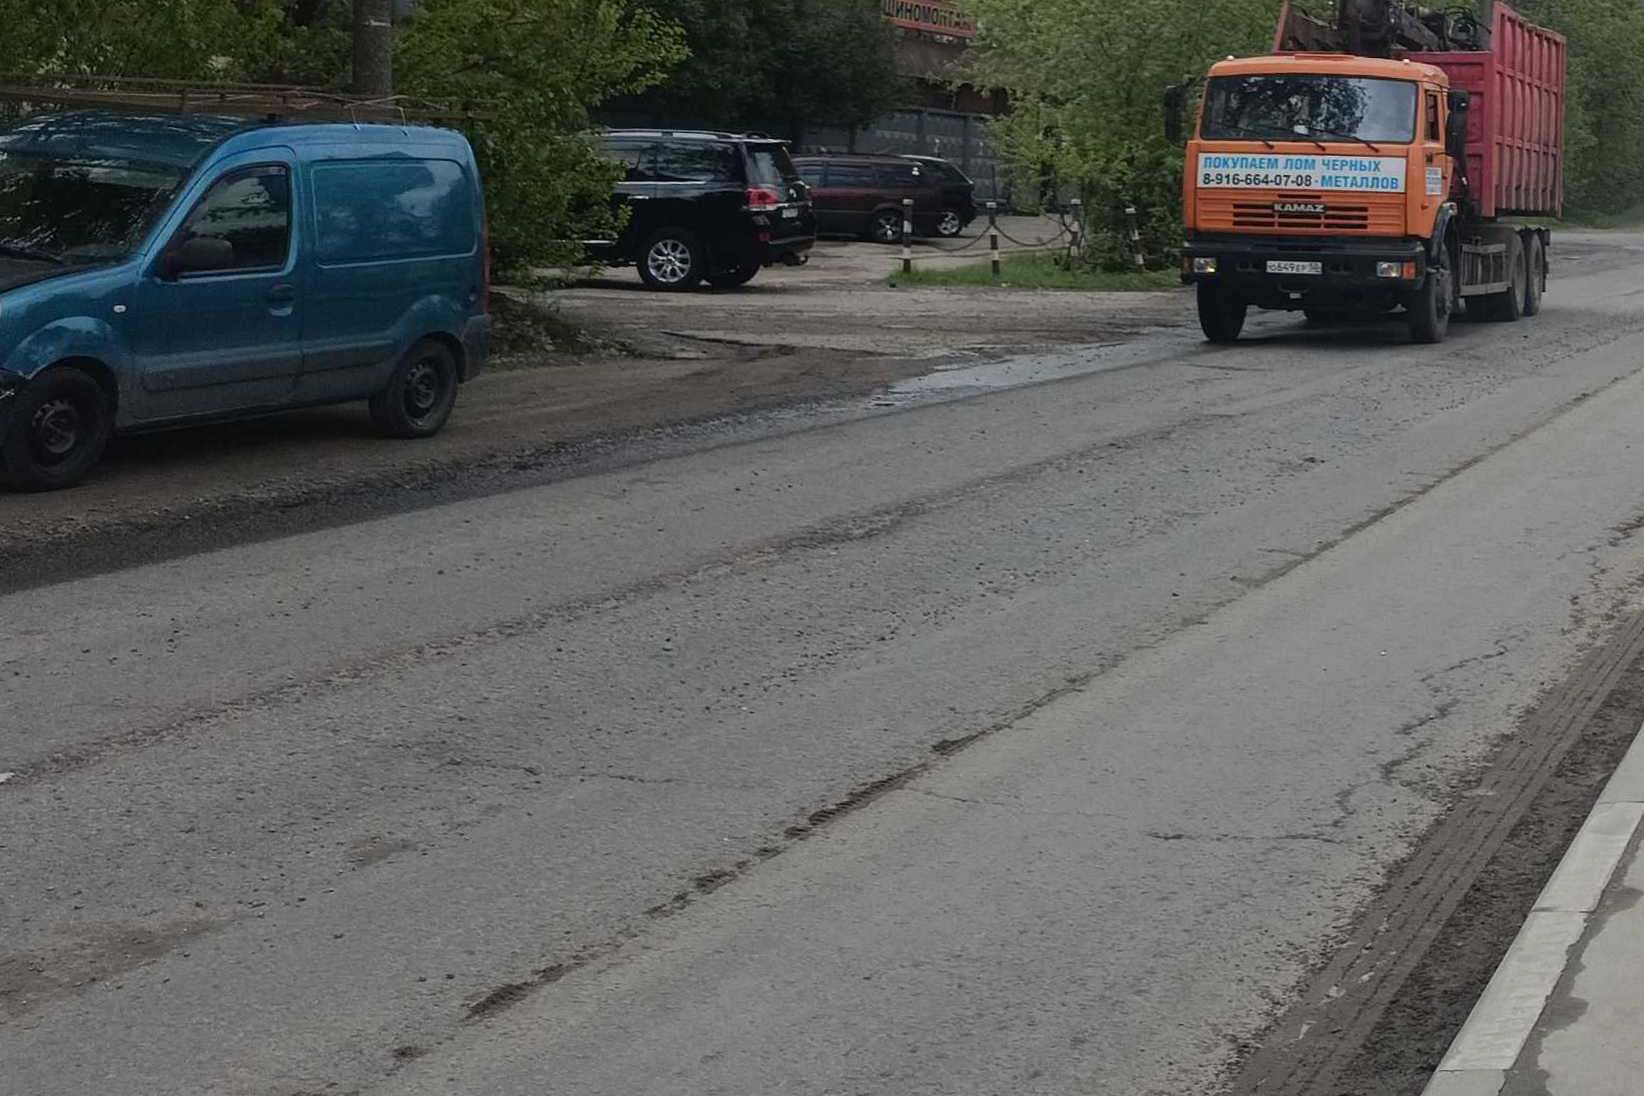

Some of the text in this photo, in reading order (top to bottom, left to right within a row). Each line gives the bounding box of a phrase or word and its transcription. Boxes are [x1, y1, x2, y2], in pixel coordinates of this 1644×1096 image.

[1203, 156, 1381, 173] ПОКУПАЕМ ЛОМ ЧЕРНЫХ
[1203, 173, 1399, 190] 8-916-664-07-08 МЕТАЛЛОВ
[1274, 203, 1326, 213] KAMAZ
